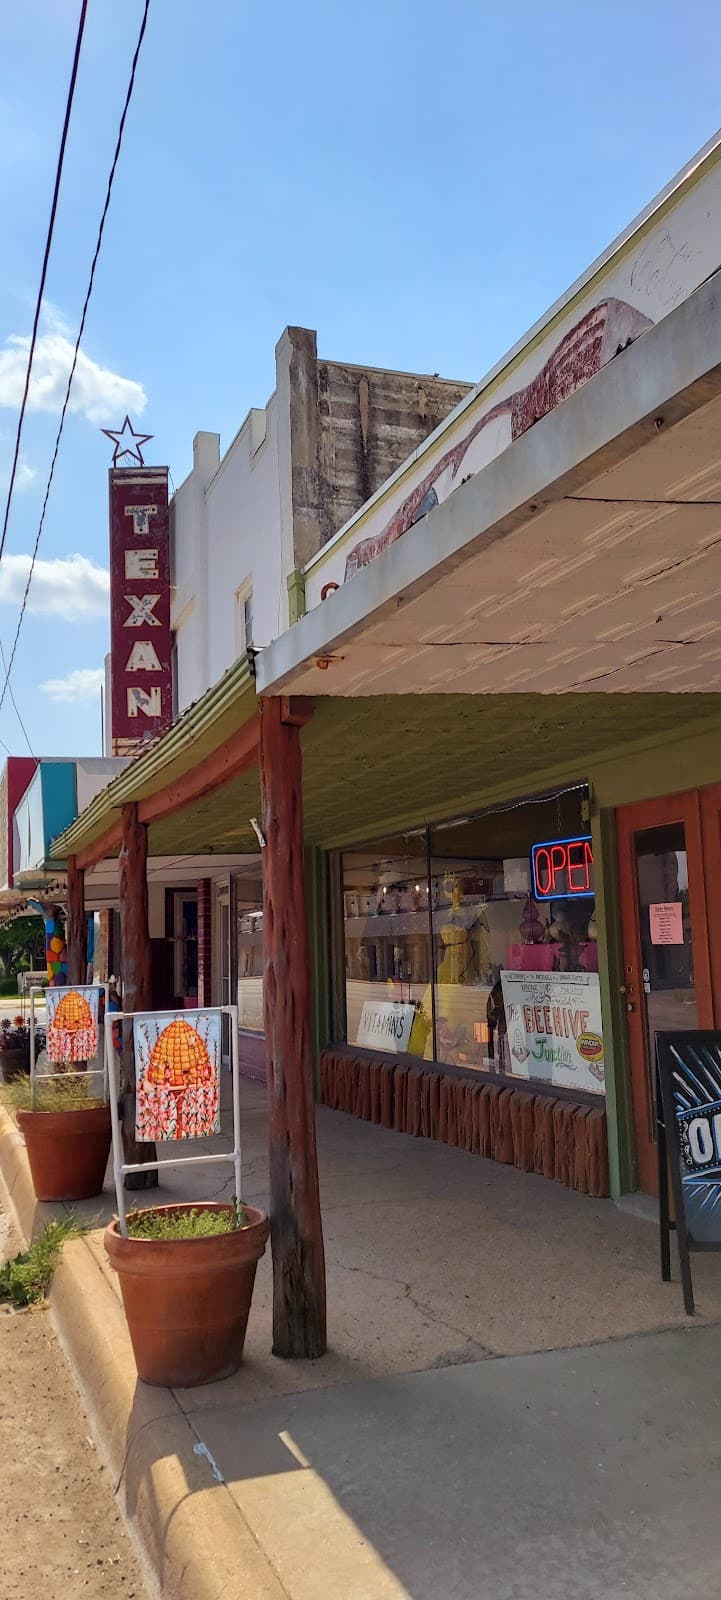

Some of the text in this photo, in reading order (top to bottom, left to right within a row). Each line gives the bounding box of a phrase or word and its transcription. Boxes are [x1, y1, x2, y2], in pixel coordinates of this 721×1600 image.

[123, 505, 163, 717] TEXAN
[363, 1011, 405, 1039] VITAMINS
[507, 1003, 590, 1040] The BEEHIVE
[531, 1039, 572, 1063] Junction
